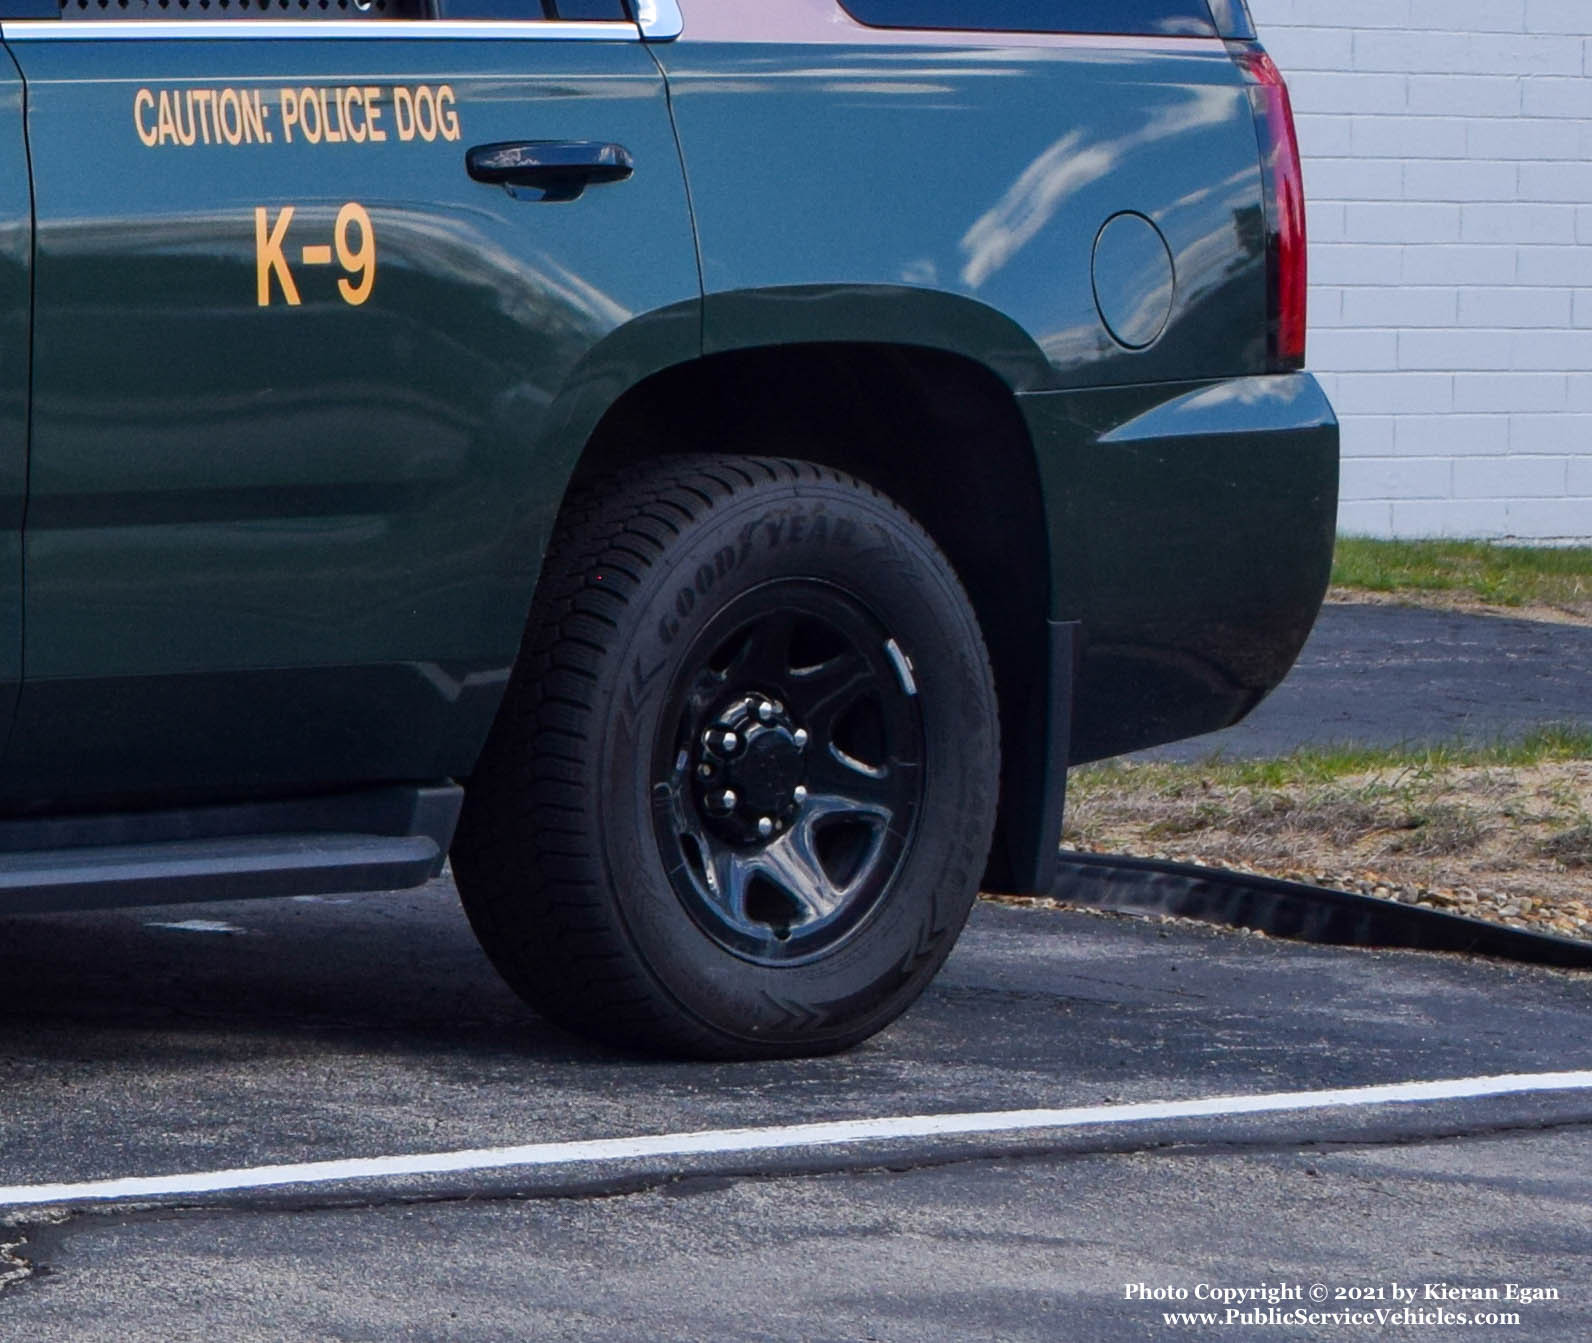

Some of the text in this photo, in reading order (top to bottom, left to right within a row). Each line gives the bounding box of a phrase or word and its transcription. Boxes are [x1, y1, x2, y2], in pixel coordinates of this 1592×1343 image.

[133, 84, 460, 146] CAUTION: POLICE DOG
[255, 202, 377, 307] K-9
